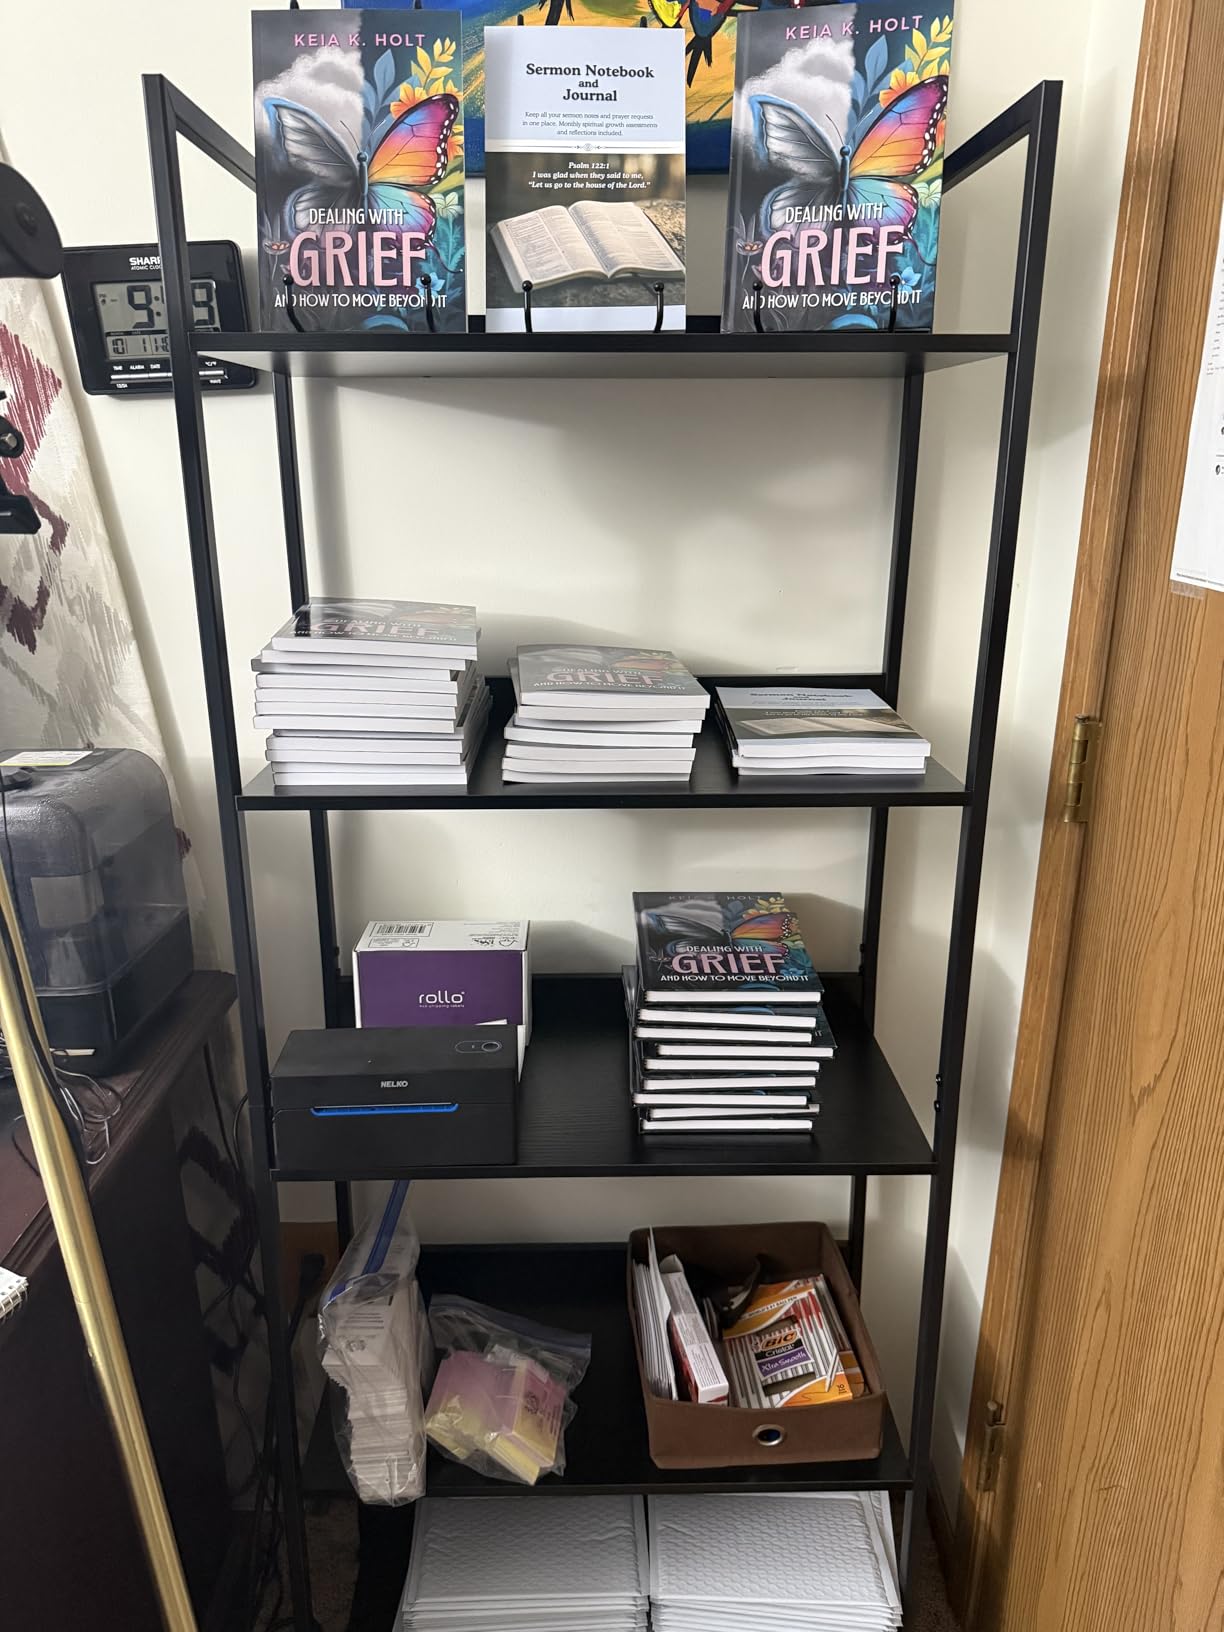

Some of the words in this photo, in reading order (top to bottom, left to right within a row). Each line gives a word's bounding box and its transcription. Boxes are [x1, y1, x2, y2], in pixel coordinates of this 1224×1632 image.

[786, 24, 832, 40] KEIA
[842, 22, 860, 36] K.
[870, 16, 923, 32] HOLT
[294, 34, 340, 46] KEIA
[348, 34, 366, 46] K.
[375, 34, 425, 46] HOLT
[526, 63, 580, 76] Sermon
[586, 64, 654, 78] Notebook
[578, 79, 598, 88] and
[563, 89, 617, 101] Journal
[553, 172, 568, 180] glad
[590, 172, 605, 180] they
[607, 182, 615, 190] of
[309, 208, 365, 225] DEALING
[368, 208, 404, 225] WITH
[786, 204, 843, 224] DEALING
[846, 203, 884, 221] WITH
[290, 231, 426, 288] GRIEF
[761, 225, 904, 288] GRIEF
[299, 294, 330, 307] HOW
[332, 294, 350, 307] TO
[352, 294, 386, 307] MOVE
[438, 294, 448, 308] IT
[768, 294, 799, 309] HOW
[801, 294, 820, 307] TO
[822, 292, 857, 307] MOVE
[912, 290, 922, 304] IT
[310, 623, 440, 637] GRIEF
[546, 672, 663, 685] GRIEF
[672, 953, 786, 974] GRIEF
[419, 990, 463, 1004] rollo
[761, 1362, 779, 1372] Xtra
[780, 1352, 807, 1366] Smooth
